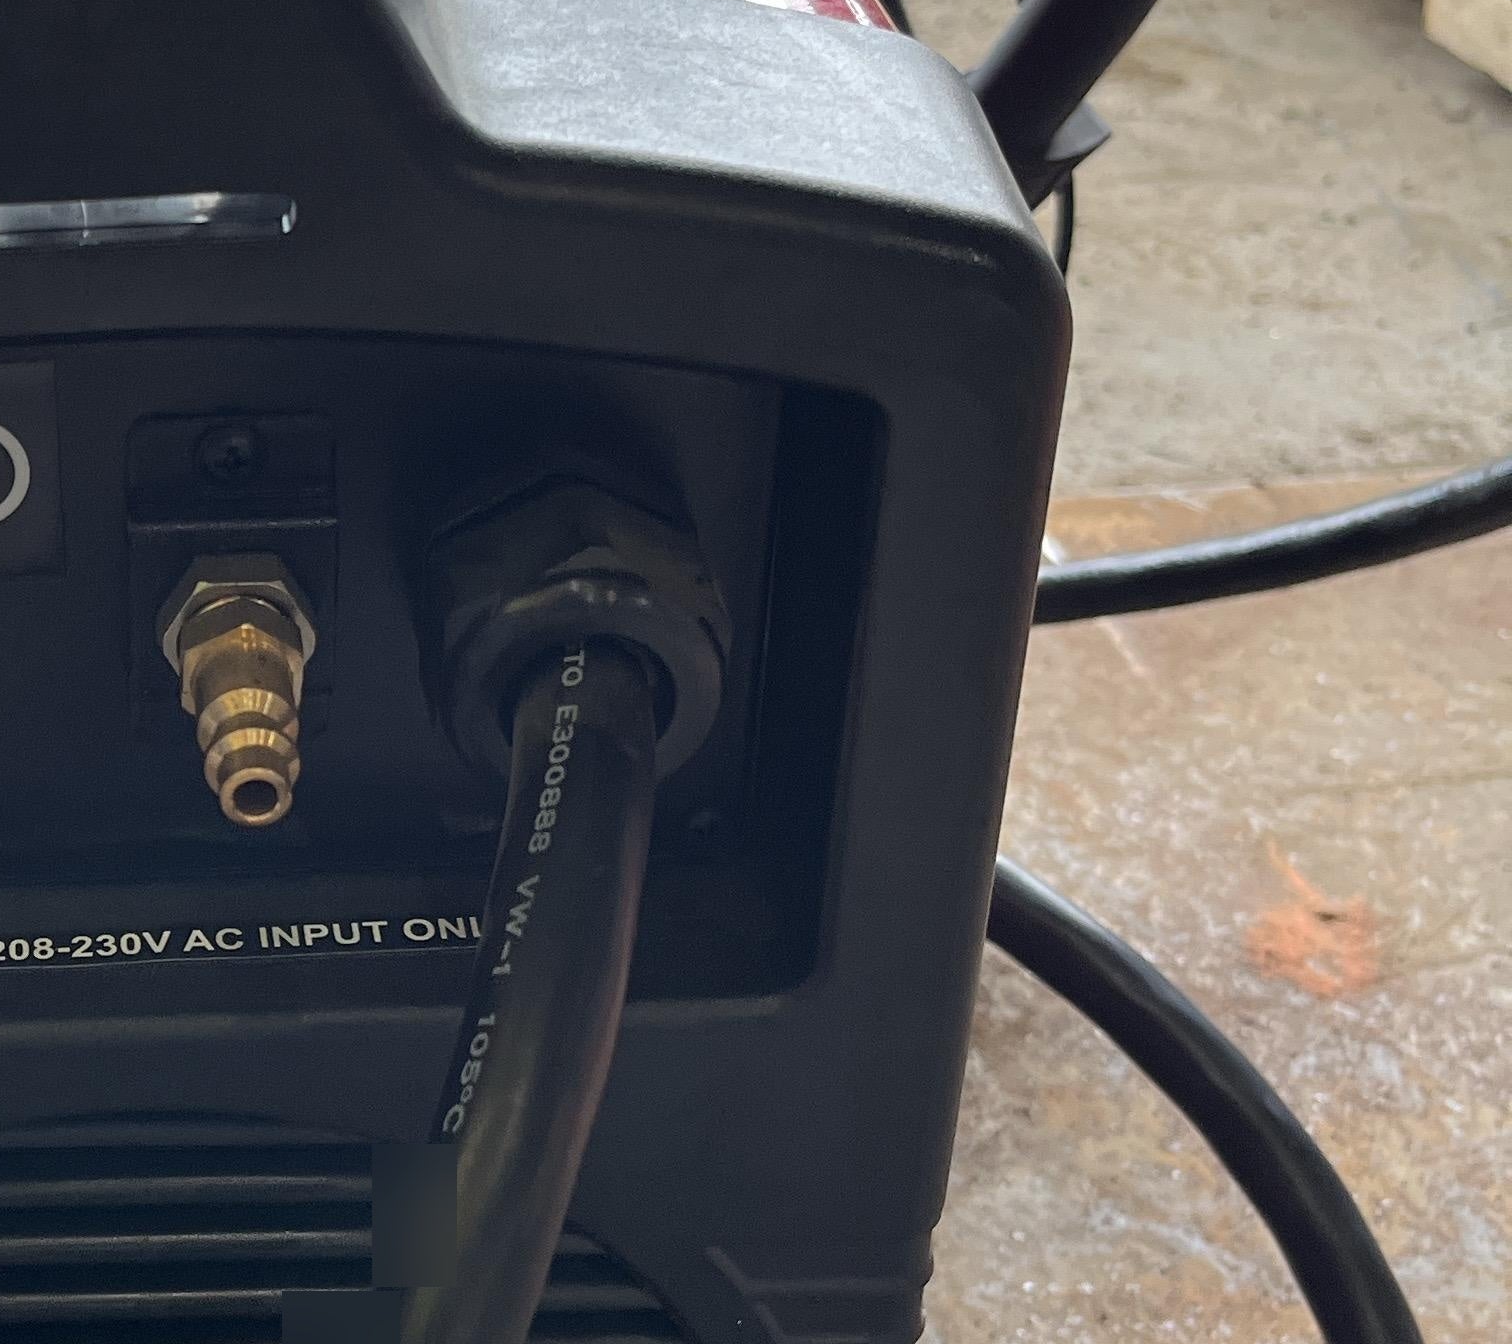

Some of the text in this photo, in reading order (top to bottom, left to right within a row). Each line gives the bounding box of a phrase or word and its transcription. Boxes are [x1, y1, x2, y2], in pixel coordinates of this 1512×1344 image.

[528, 703, 579, 856] E300888
[182, 927, 245, 952] AC
[258, 919, 389, 948] INPUT
[402, 915, 482, 942] ONL
[491, 874, 540, 977] VW-1
